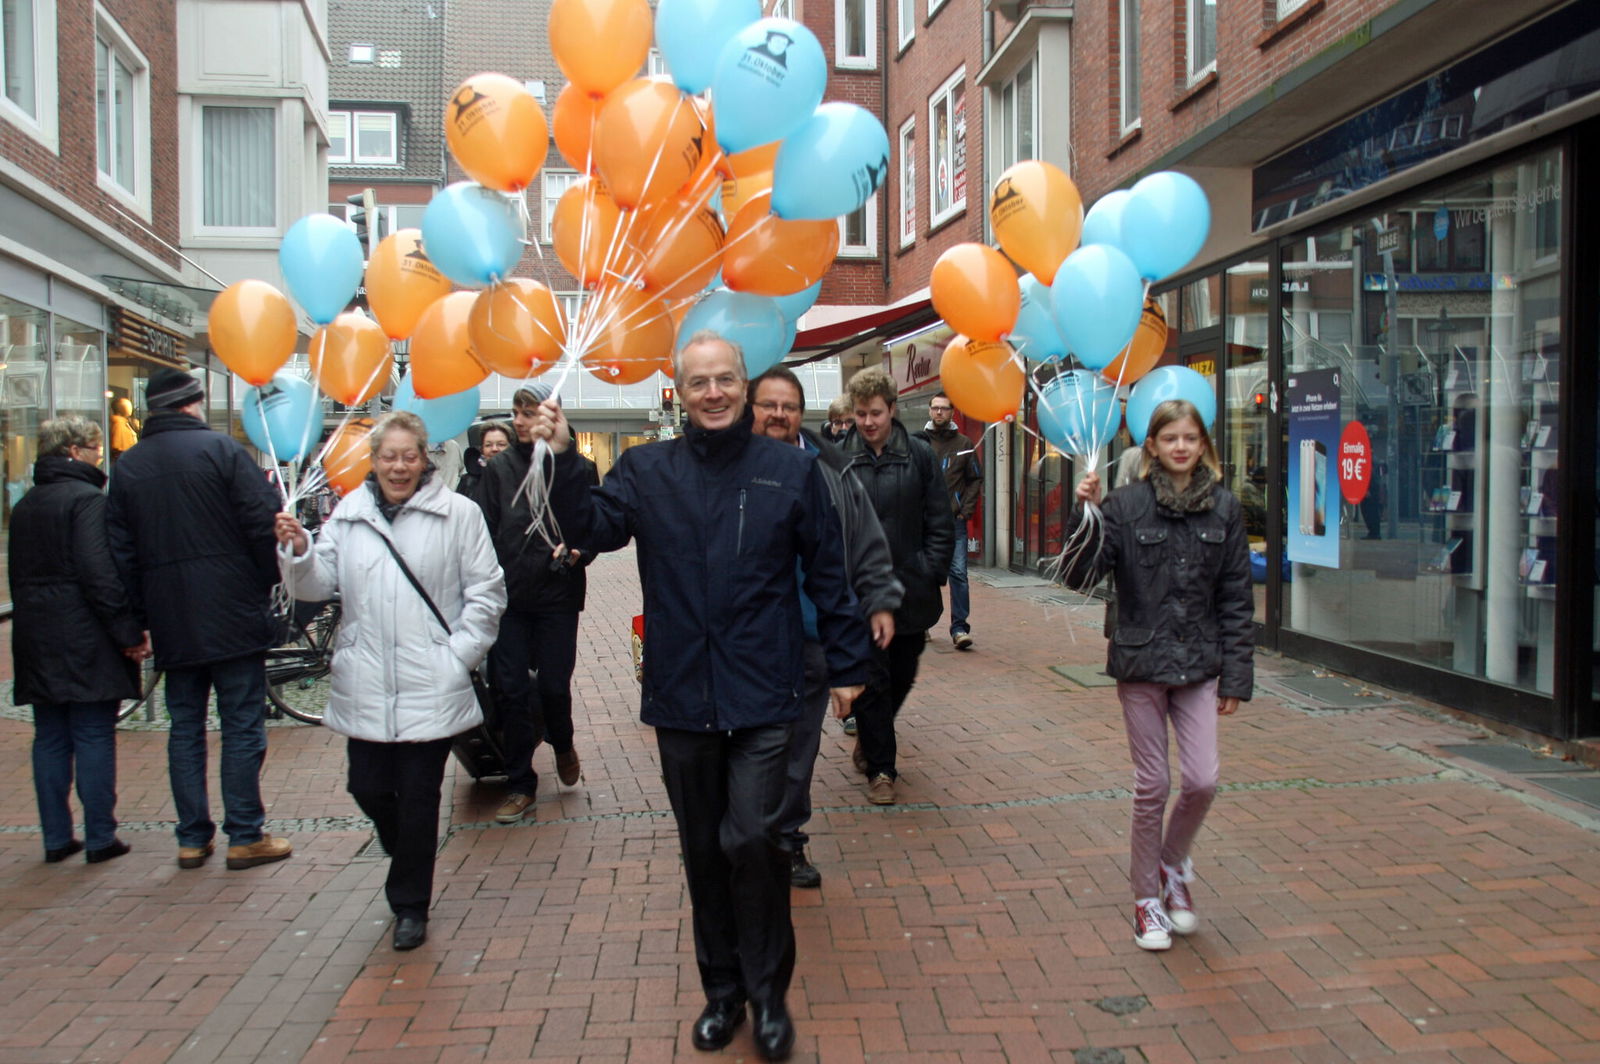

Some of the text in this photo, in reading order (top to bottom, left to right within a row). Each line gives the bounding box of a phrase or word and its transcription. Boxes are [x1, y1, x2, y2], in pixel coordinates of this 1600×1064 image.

[1454, 207, 1471, 230] Wir
[1528, 183, 1561, 213] gerne
[1379, 233, 1399, 250] BASE
[1343, 442, 1365, 456] Einmalig
[1342, 458, 1353, 480] 19
